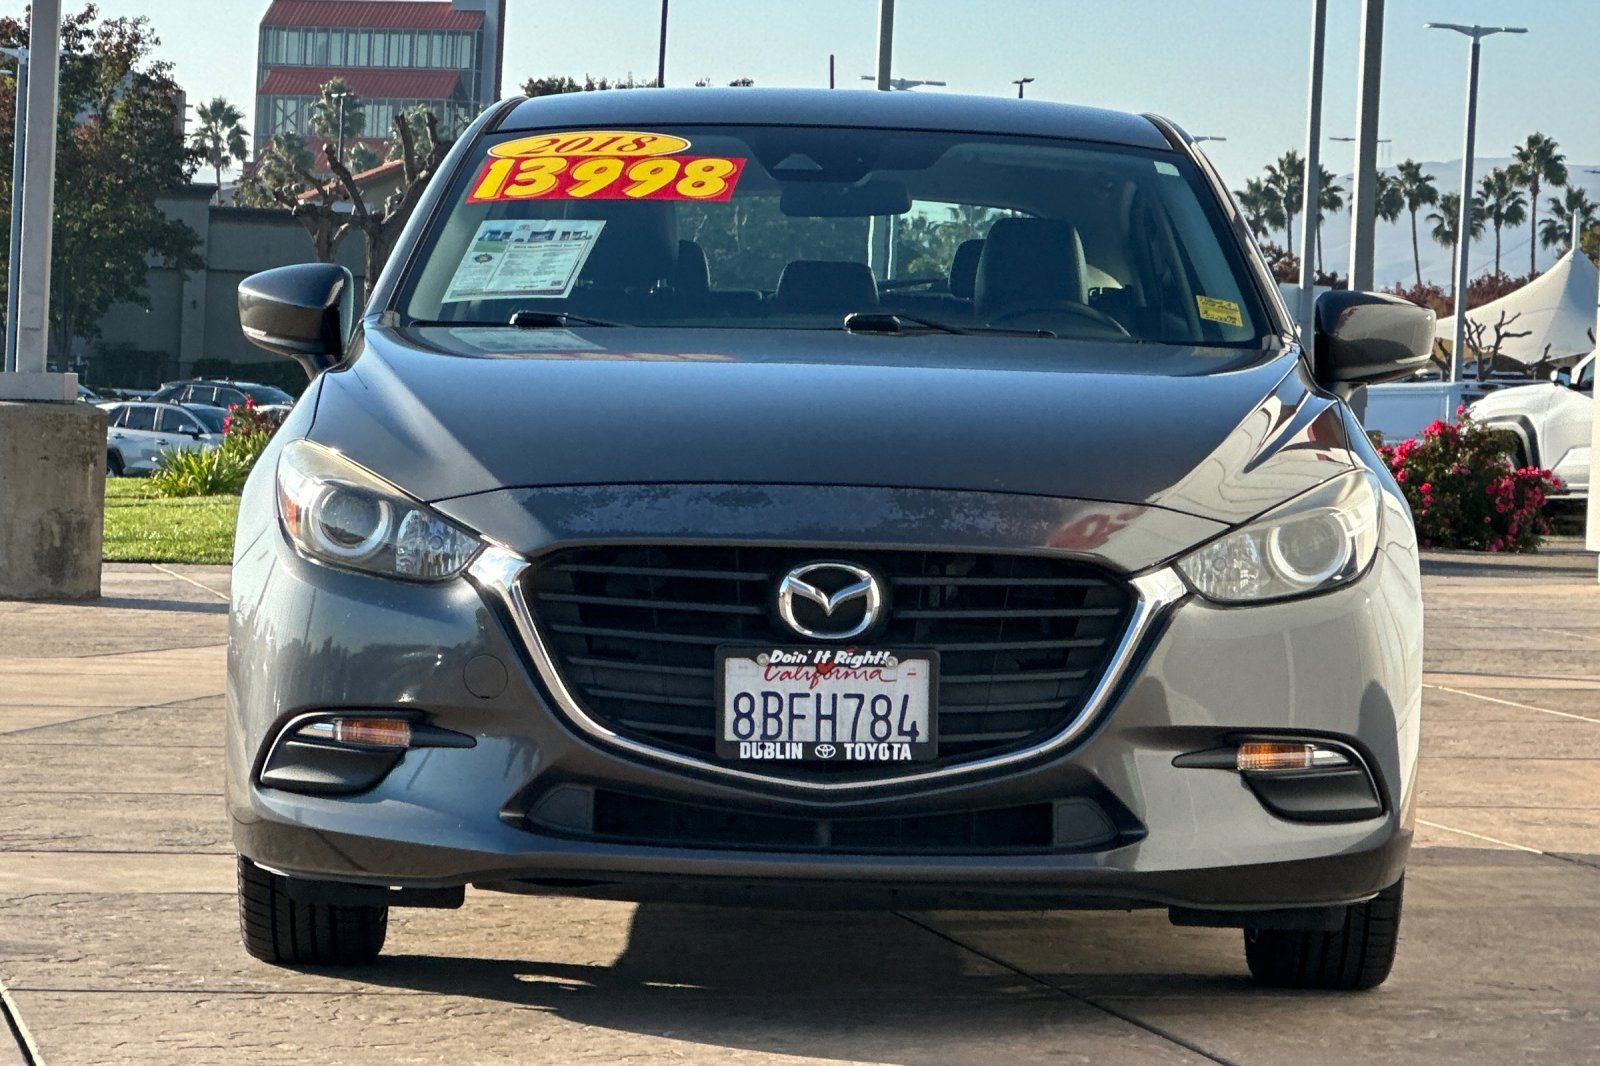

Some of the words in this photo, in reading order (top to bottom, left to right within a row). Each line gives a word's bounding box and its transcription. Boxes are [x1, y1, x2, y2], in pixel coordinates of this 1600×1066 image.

[518, 135, 659, 156] 2018
[472, 156, 738, 199] 13998
[769, 649, 812, 665] Doin'
[813, 650, 832, 664] It
[834, 650, 891, 669] Right!
[764, 664, 897, 690] California
[732, 691, 920, 743] 8BFH784
[739, 742, 803, 760] DUBLIN
[844, 743, 913, 761] TOYOTA
